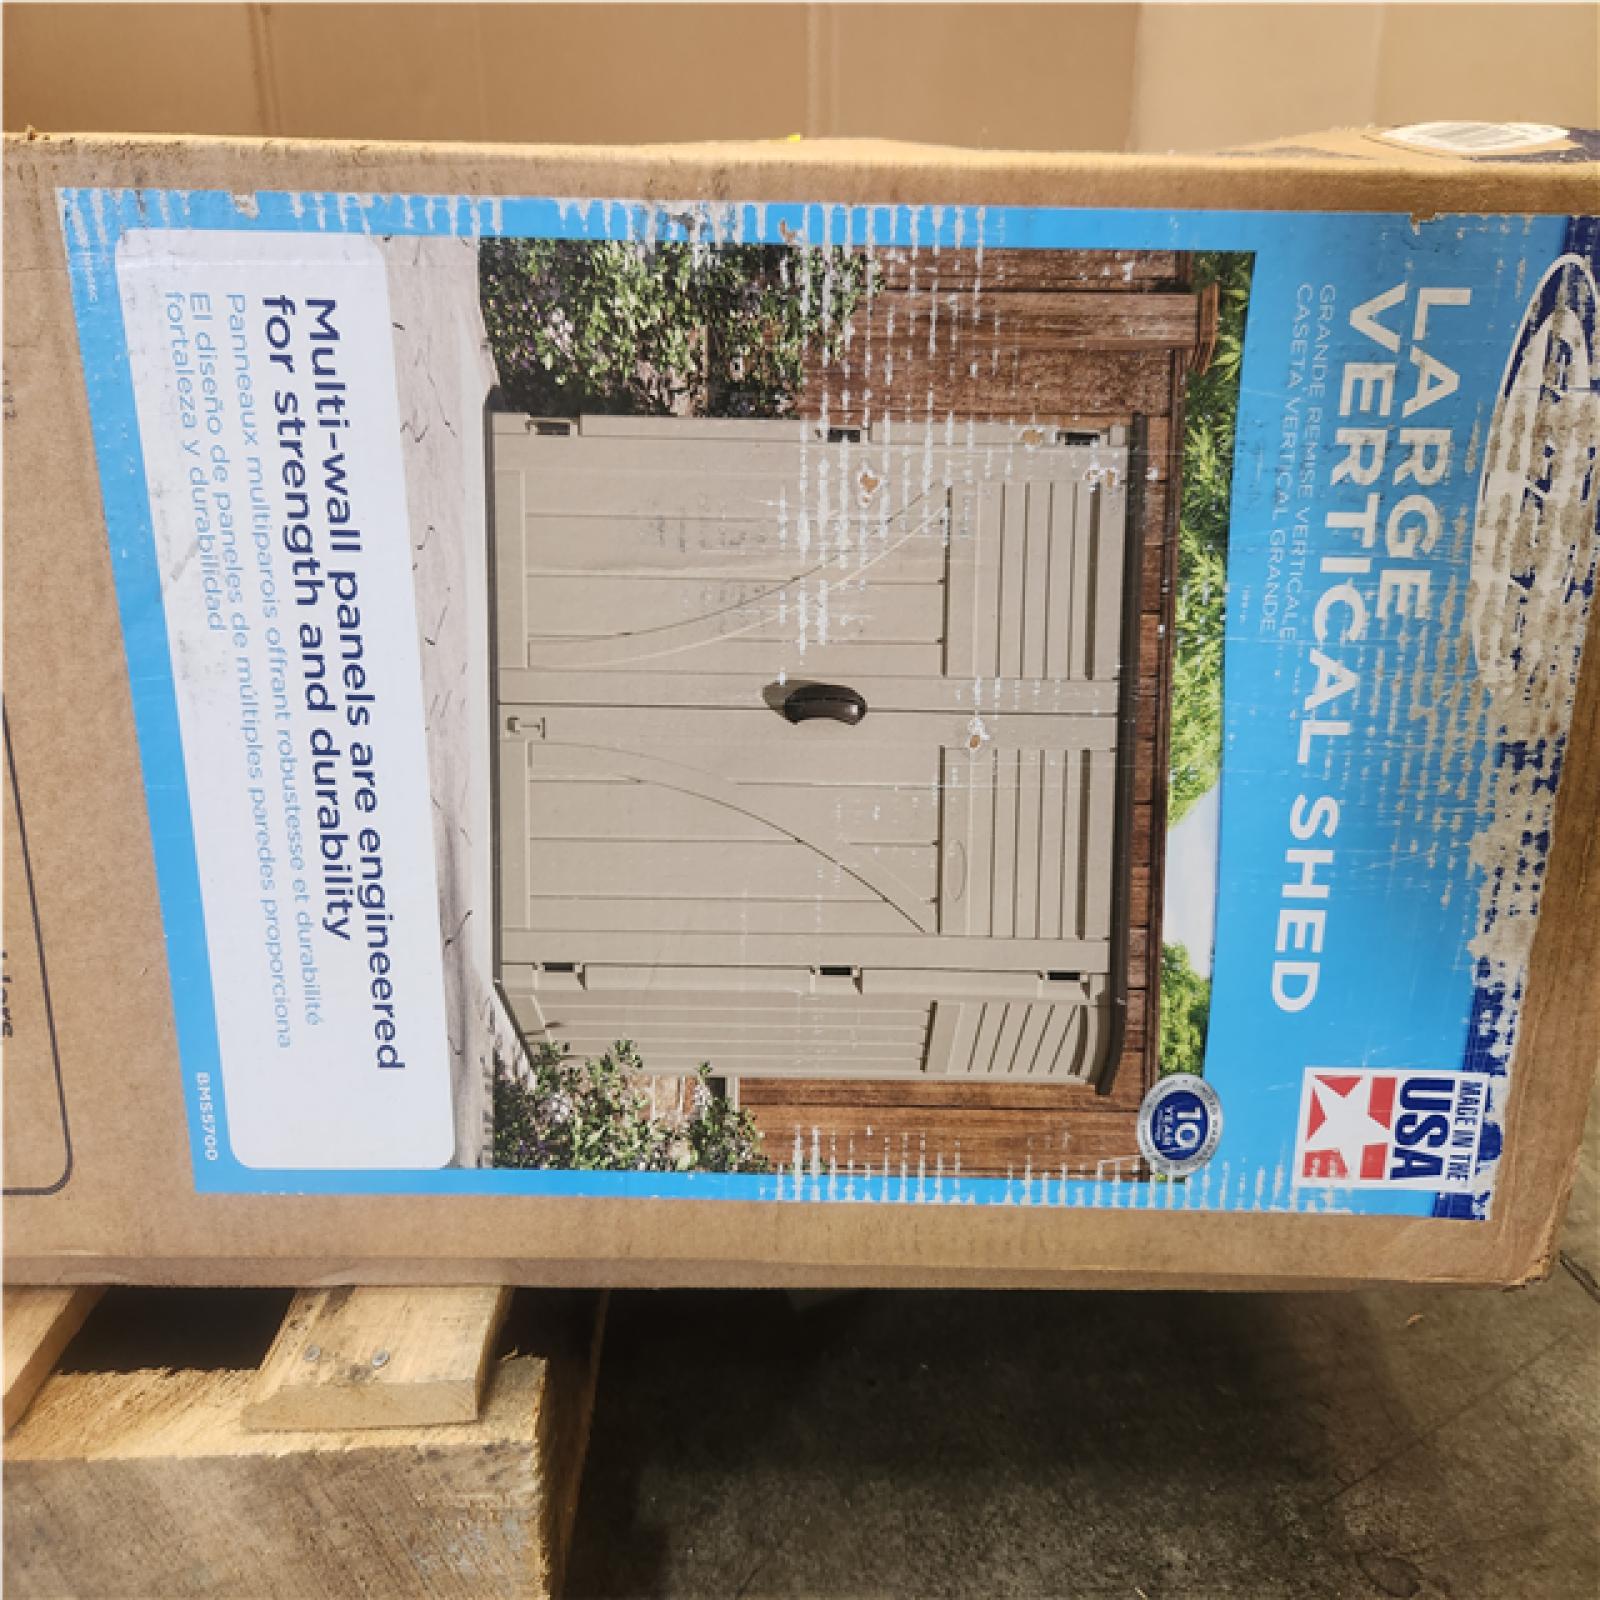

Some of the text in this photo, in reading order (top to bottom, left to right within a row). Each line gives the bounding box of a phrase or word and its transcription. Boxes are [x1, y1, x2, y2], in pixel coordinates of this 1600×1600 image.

[165, 292, 227, 631] fortaleza y durabilidad
[263, 296, 353, 940] for strength and durability
[1260, 284, 1313, 634] CASETA VERTICAL GRANDE
[1279, 285, 1335, 641] GRANDE REMISE VERTICALE
[1376, 287, 1470, 620] LARGE
[189, 292, 294, 1048] El diseño de paneles de múltiples paredes proporciona
[227, 293, 323, 1026] Panneaux multiparois offrant robustesse et durabilité
[305, 299, 405, 1069] Multi-wall panels are engineered
[1272, 285, 1407, 1011] VERTICAL SHED
[196, 1072, 218, 1161] BMS5700
[1175, 1107, 1201, 1148] 10
[1390, 1078, 1455, 1180] USA
[1447, 1081, 1483, 1180] MADE IN THE
